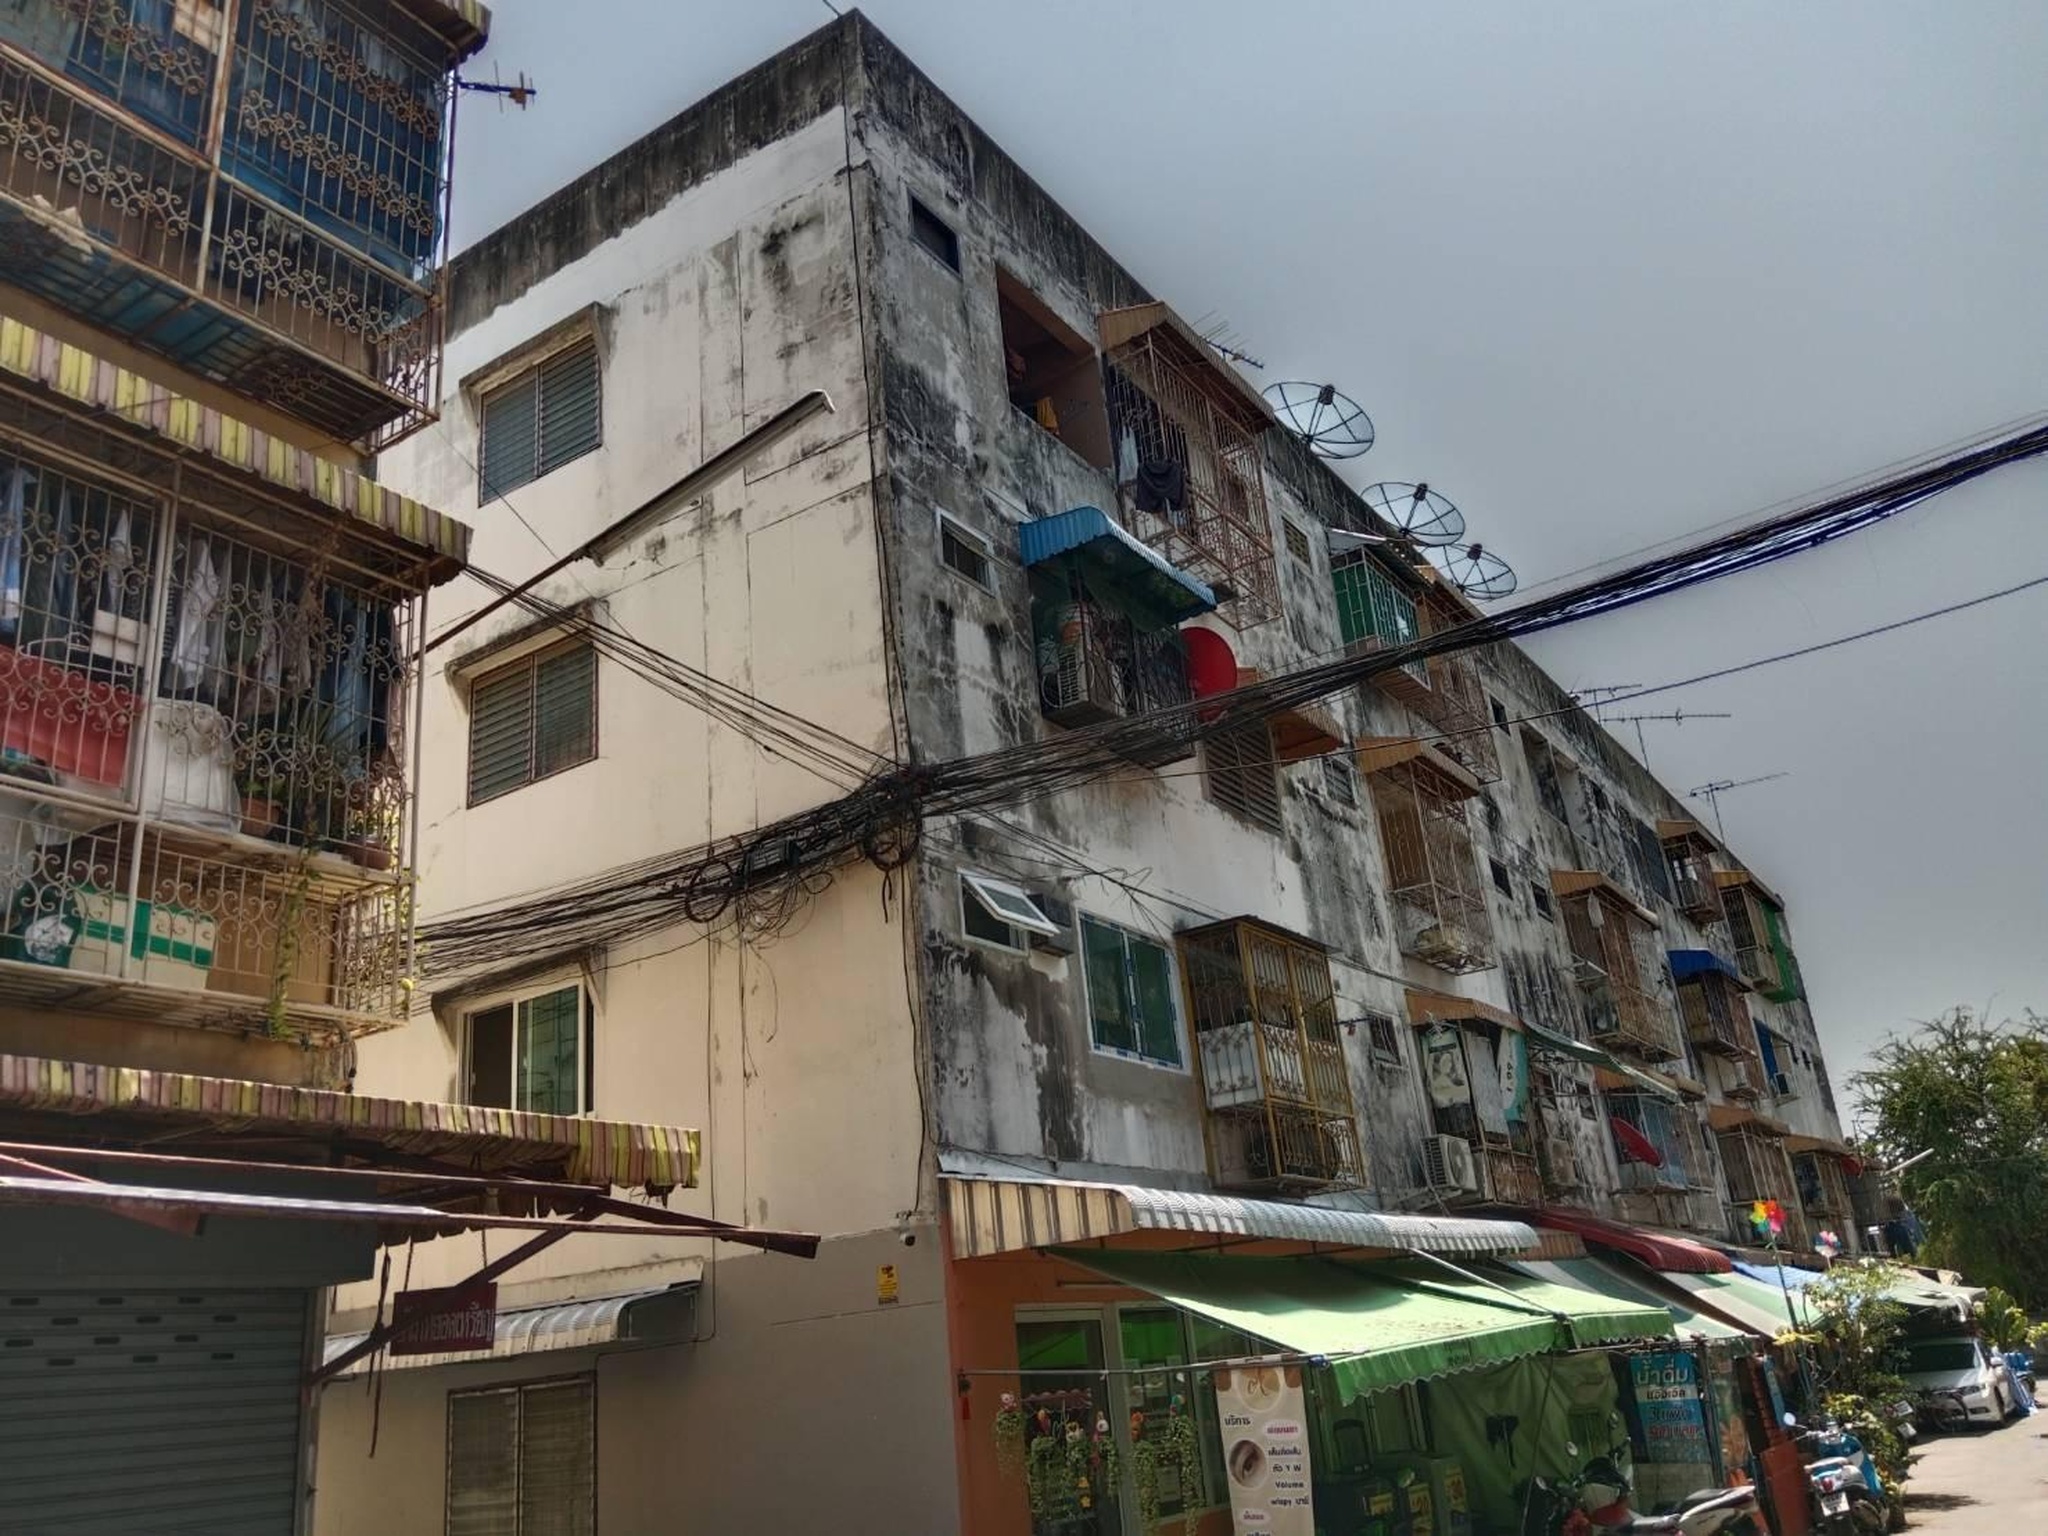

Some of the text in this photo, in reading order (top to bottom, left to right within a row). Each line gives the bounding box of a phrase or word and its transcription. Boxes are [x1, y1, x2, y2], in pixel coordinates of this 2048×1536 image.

[1224, 1414, 1251, 1426] บริการ
[1275, 1481, 1304, 1489] Volume
